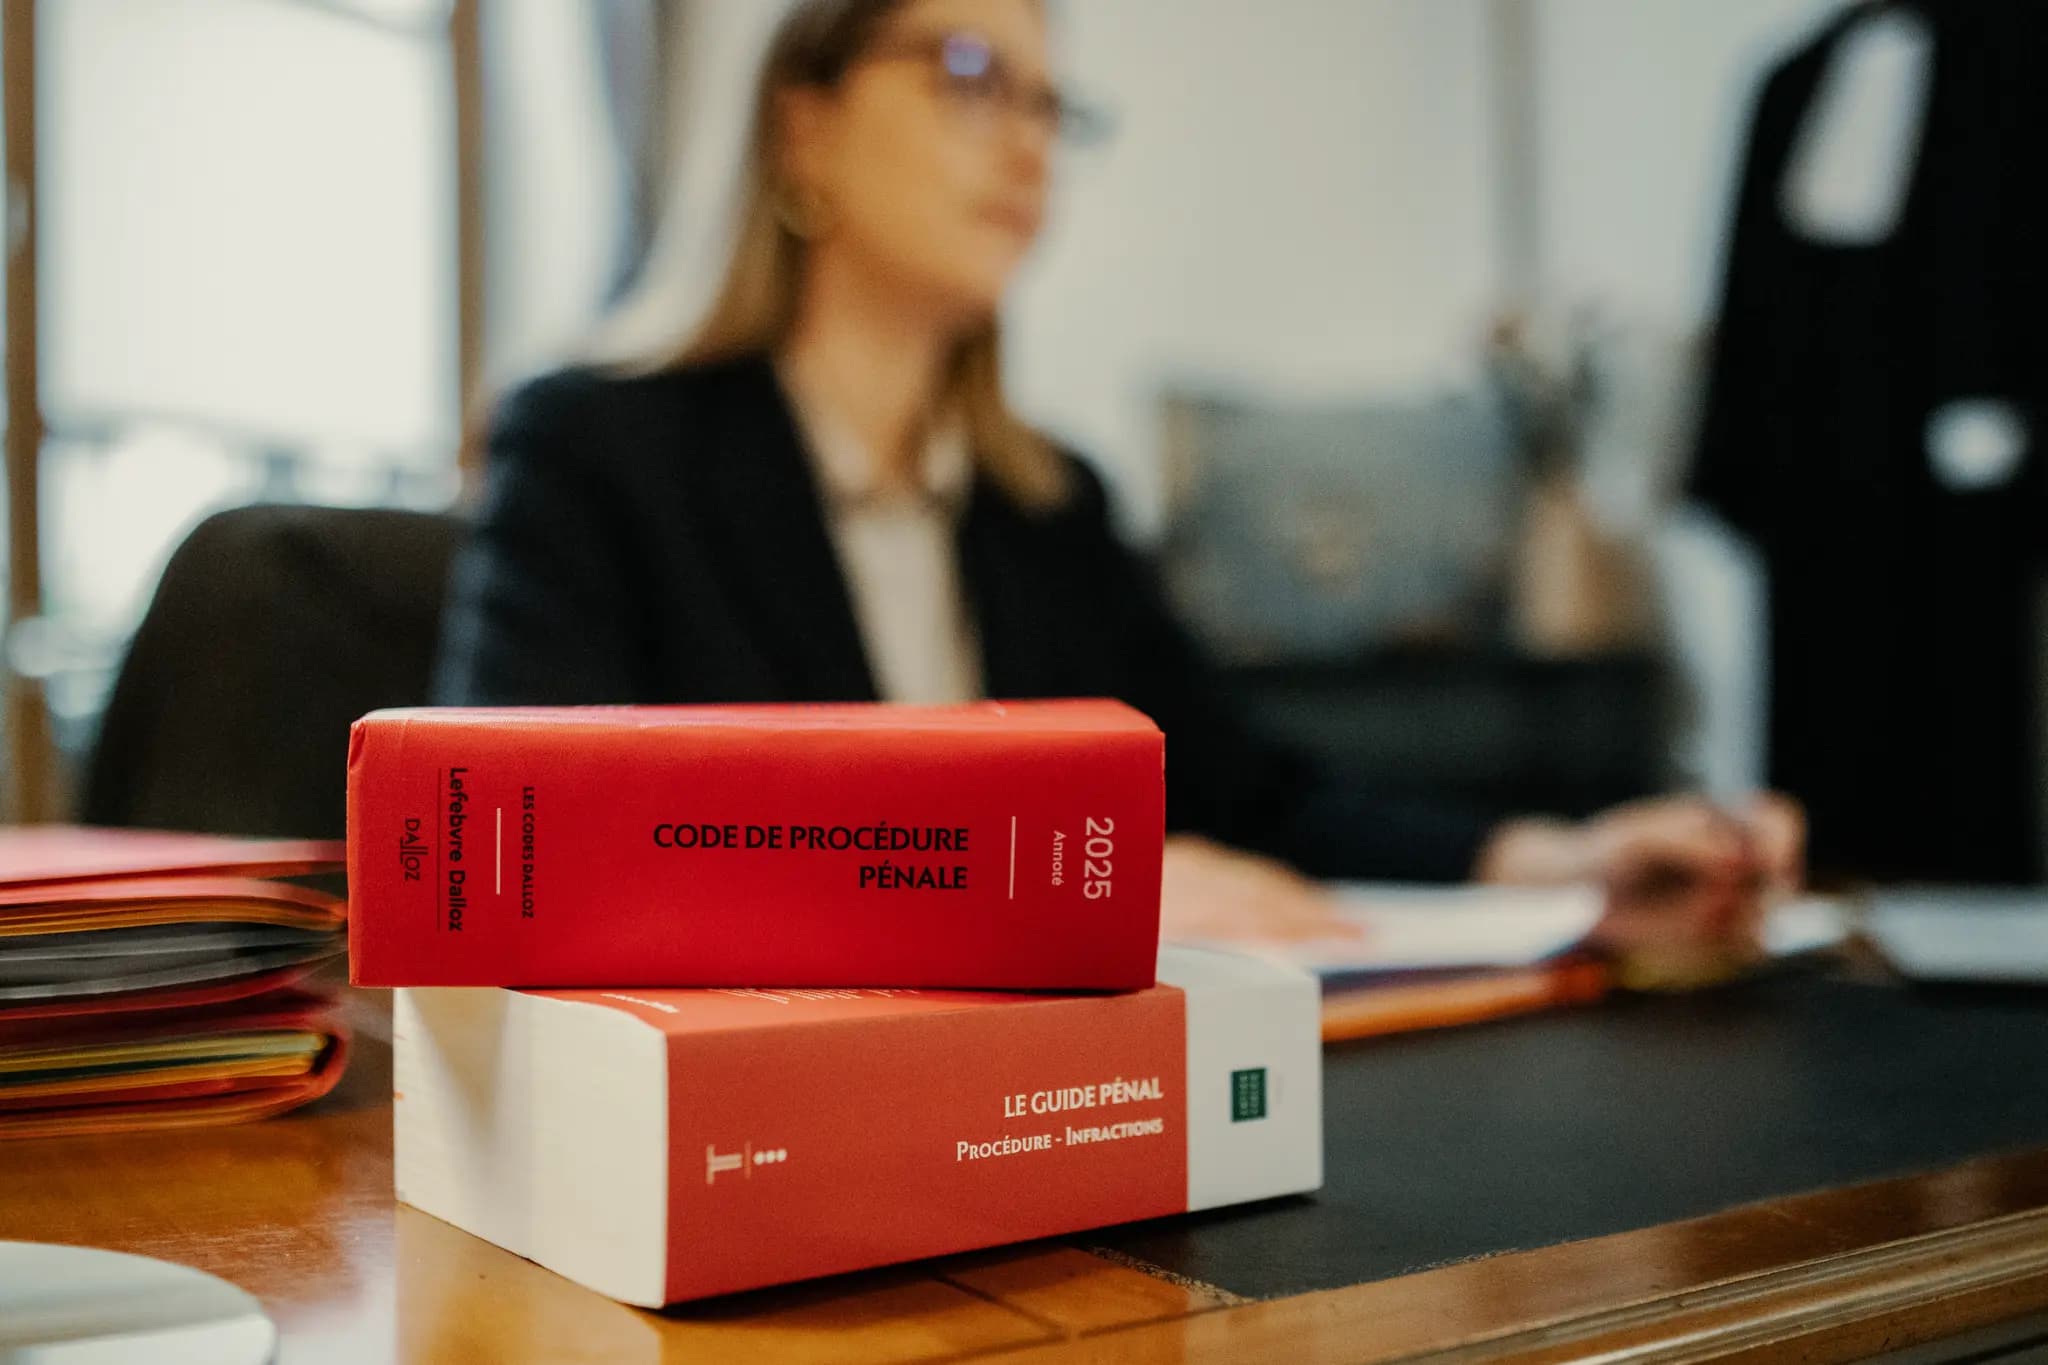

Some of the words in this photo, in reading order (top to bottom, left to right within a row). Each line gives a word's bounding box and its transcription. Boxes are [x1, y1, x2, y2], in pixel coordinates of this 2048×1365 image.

[449, 767, 469, 863] Lefebvre
[523, 786, 535, 810] LES
[522, 812, 535, 861] CODES
[653, 823, 738, 849] CODE
[745, 824, 782, 849] DE
[789, 821, 969, 852] PROCÉDURE
[1052, 830, 1067, 887] Annoté
[1083, 817, 1114, 899] 2025
[449, 870, 468, 932] Dalloz
[522, 863, 534, 919] DALLOZ
[859, 860, 968, 890] PÉNALE
[1004, 1094, 1027, 1118] LE
[1031, 1085, 1096, 1115] GUIDE
[1100, 1076, 1164, 1106] PÉNAL
